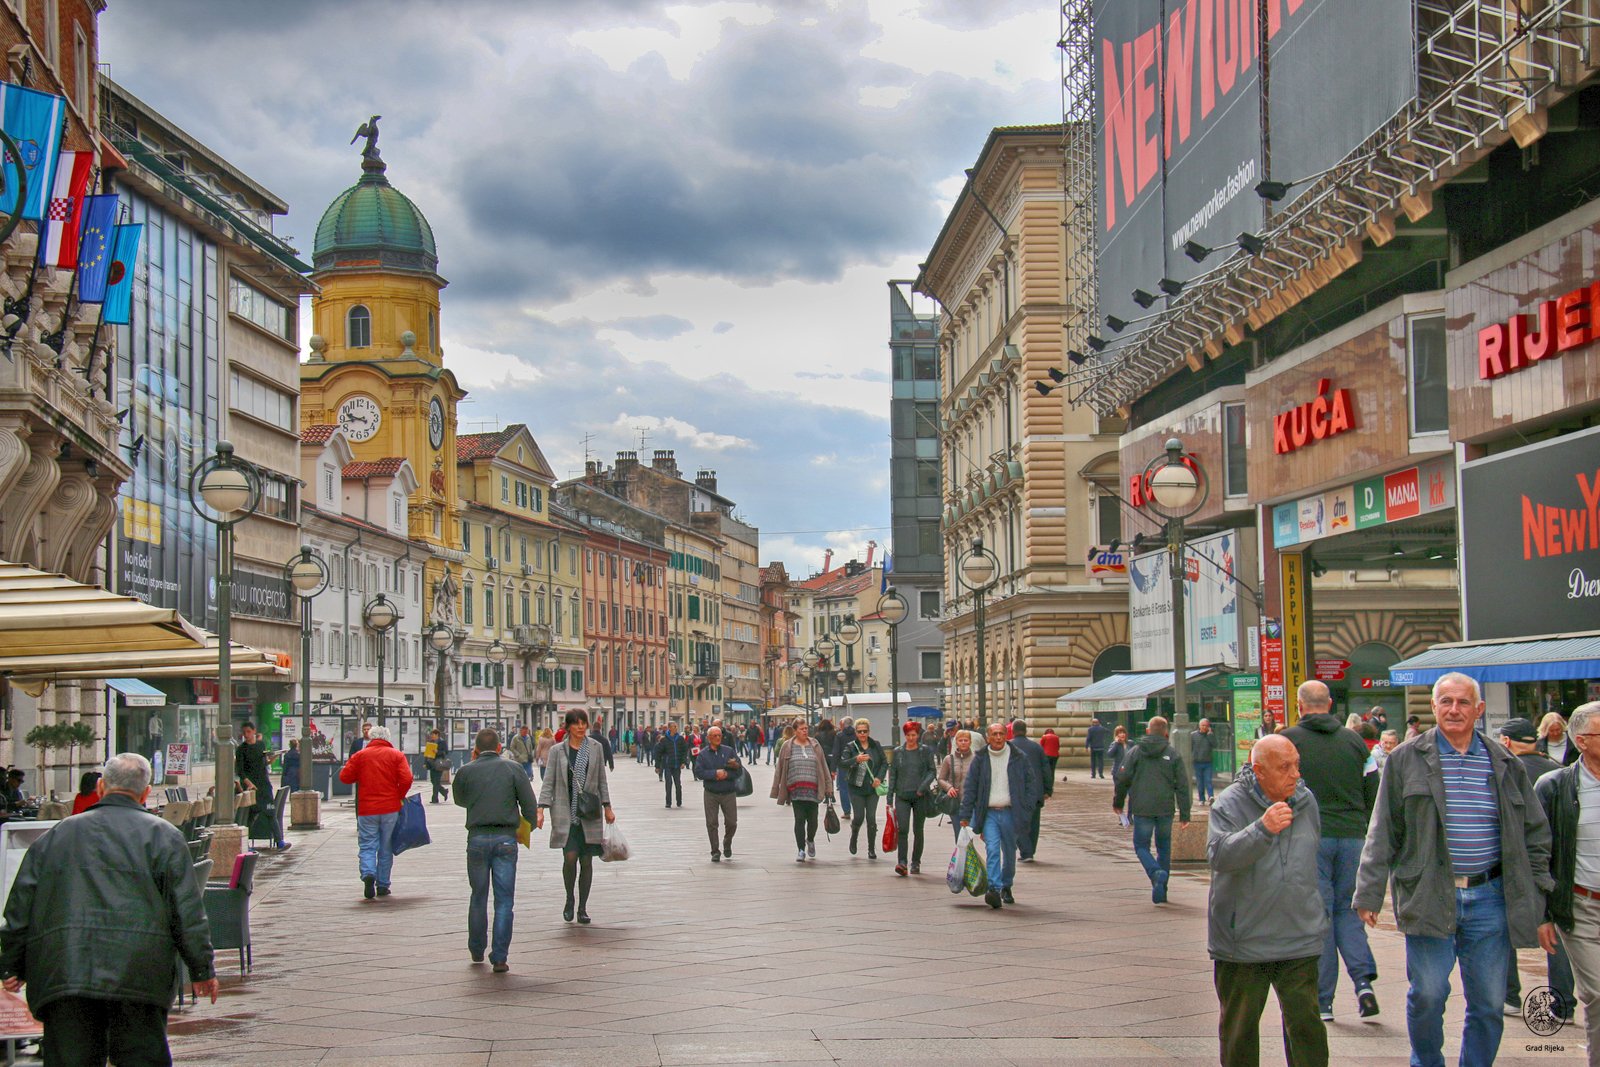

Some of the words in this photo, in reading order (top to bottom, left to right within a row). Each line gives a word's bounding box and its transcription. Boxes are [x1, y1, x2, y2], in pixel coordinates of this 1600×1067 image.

[1171, 159, 1256, 251] www.newyorker.fashion
[350, 401, 355, 410] 11
[356, 399, 364, 408] 12
[366, 401, 370, 409] 1
[370, 405, 375, 414] 2
[339, 415, 346, 423] 9
[373, 414, 379, 423] 3
[1273, 378, 1356, 455] KUĆA
[342, 424, 349, 433] 8
[369, 422, 375, 431] 4
[350, 430, 355, 438] 7
[356, 431, 362, 440] 6
[363, 429, 369, 438] 5
[1388, 481, 1418, 508] MANA
[1333, 496, 1346, 518] dm
[1521, 467, 1600, 561] NEWY
[1097, 552, 1123, 565] dm
[1288, 560, 1298, 627] HAPPY
[1291, 634, 1300, 688] HOME
[1372, 679, 1391, 687] HPB
